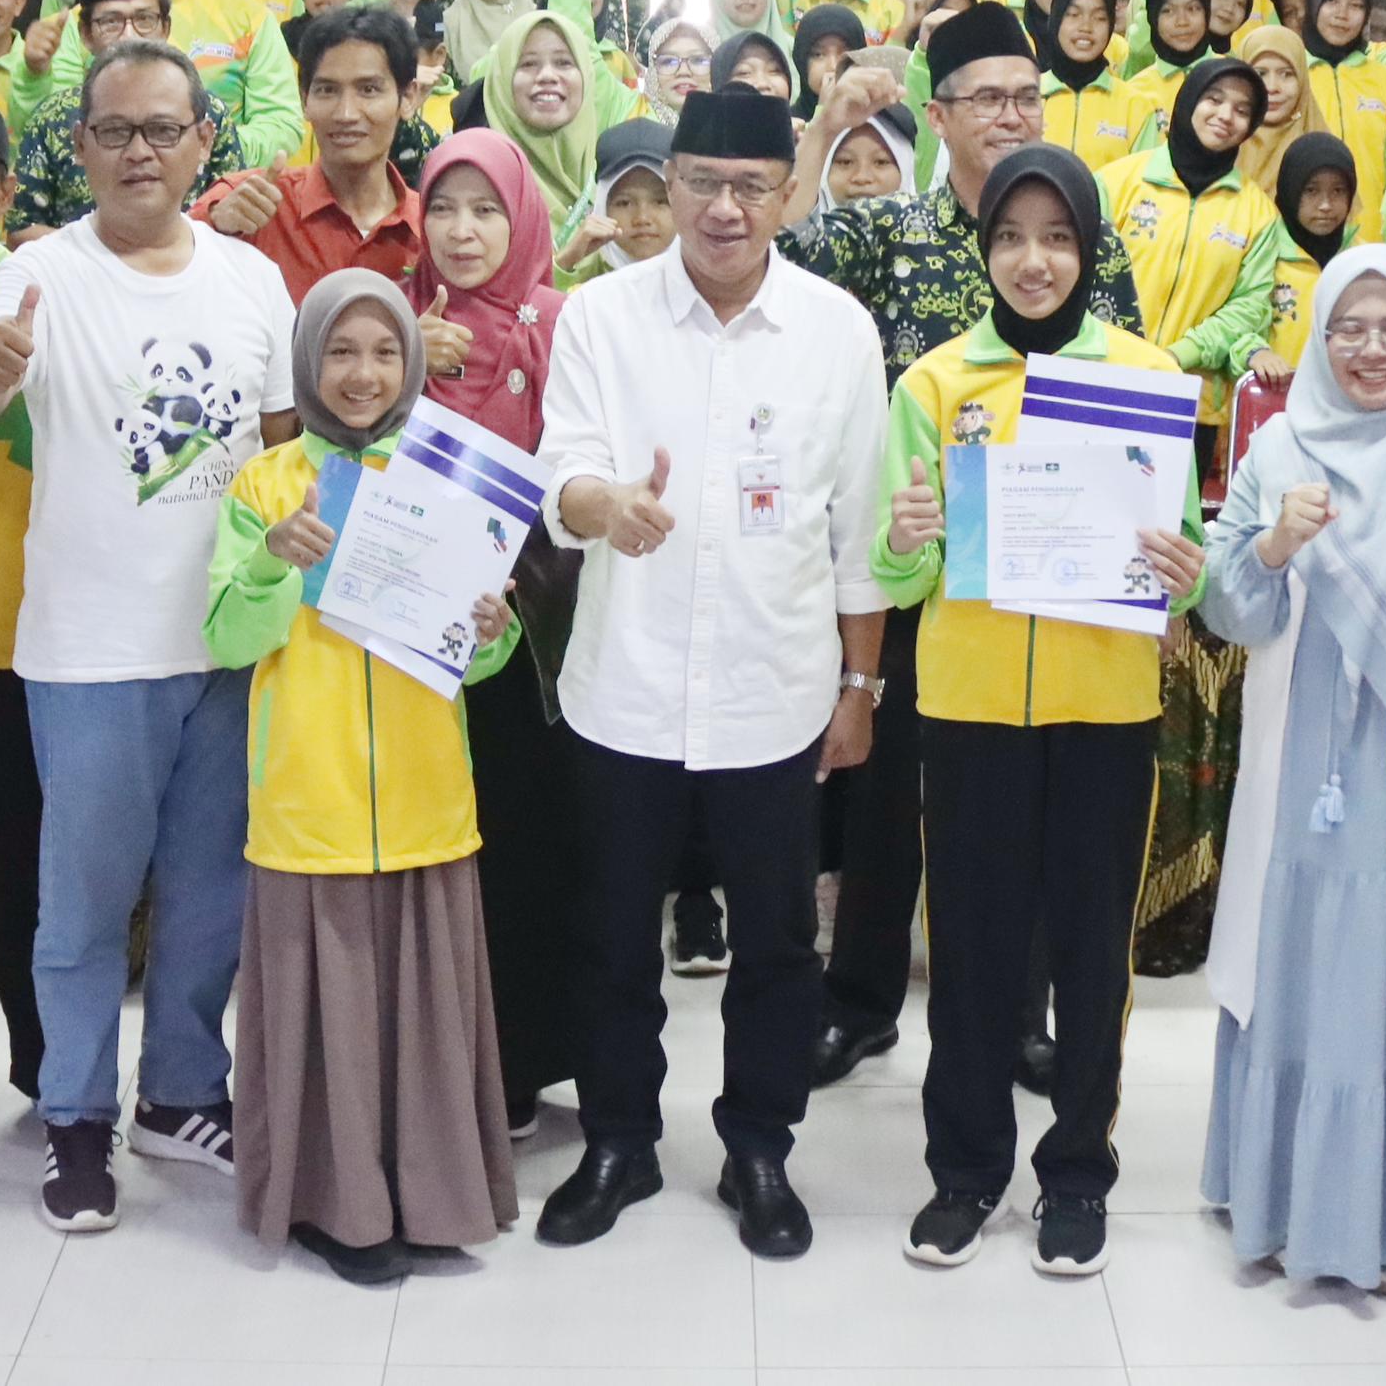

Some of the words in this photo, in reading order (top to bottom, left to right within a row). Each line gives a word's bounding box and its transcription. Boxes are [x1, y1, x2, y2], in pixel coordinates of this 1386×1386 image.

[203, 459, 237, 472] CHINA
[189, 468, 240, 490] PAND
[158, 488, 208, 504] national
